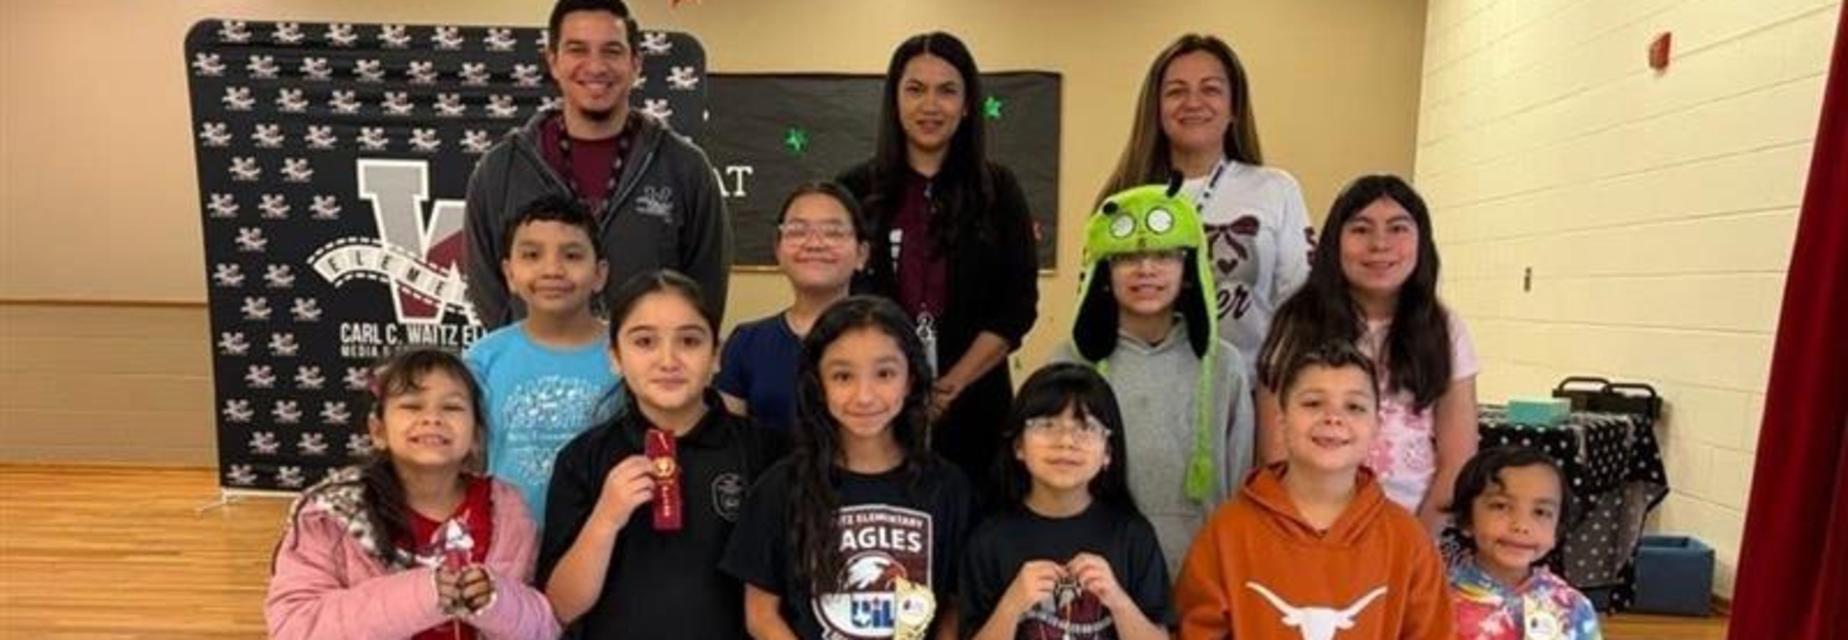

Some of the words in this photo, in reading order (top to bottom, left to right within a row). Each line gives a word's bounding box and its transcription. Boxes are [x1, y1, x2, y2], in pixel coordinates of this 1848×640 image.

[340, 322, 383, 344] CARL
[385, 322, 403, 345] C.
[406, 323, 459, 346] WAITZ
[340, 345, 378, 358] MEDIA
